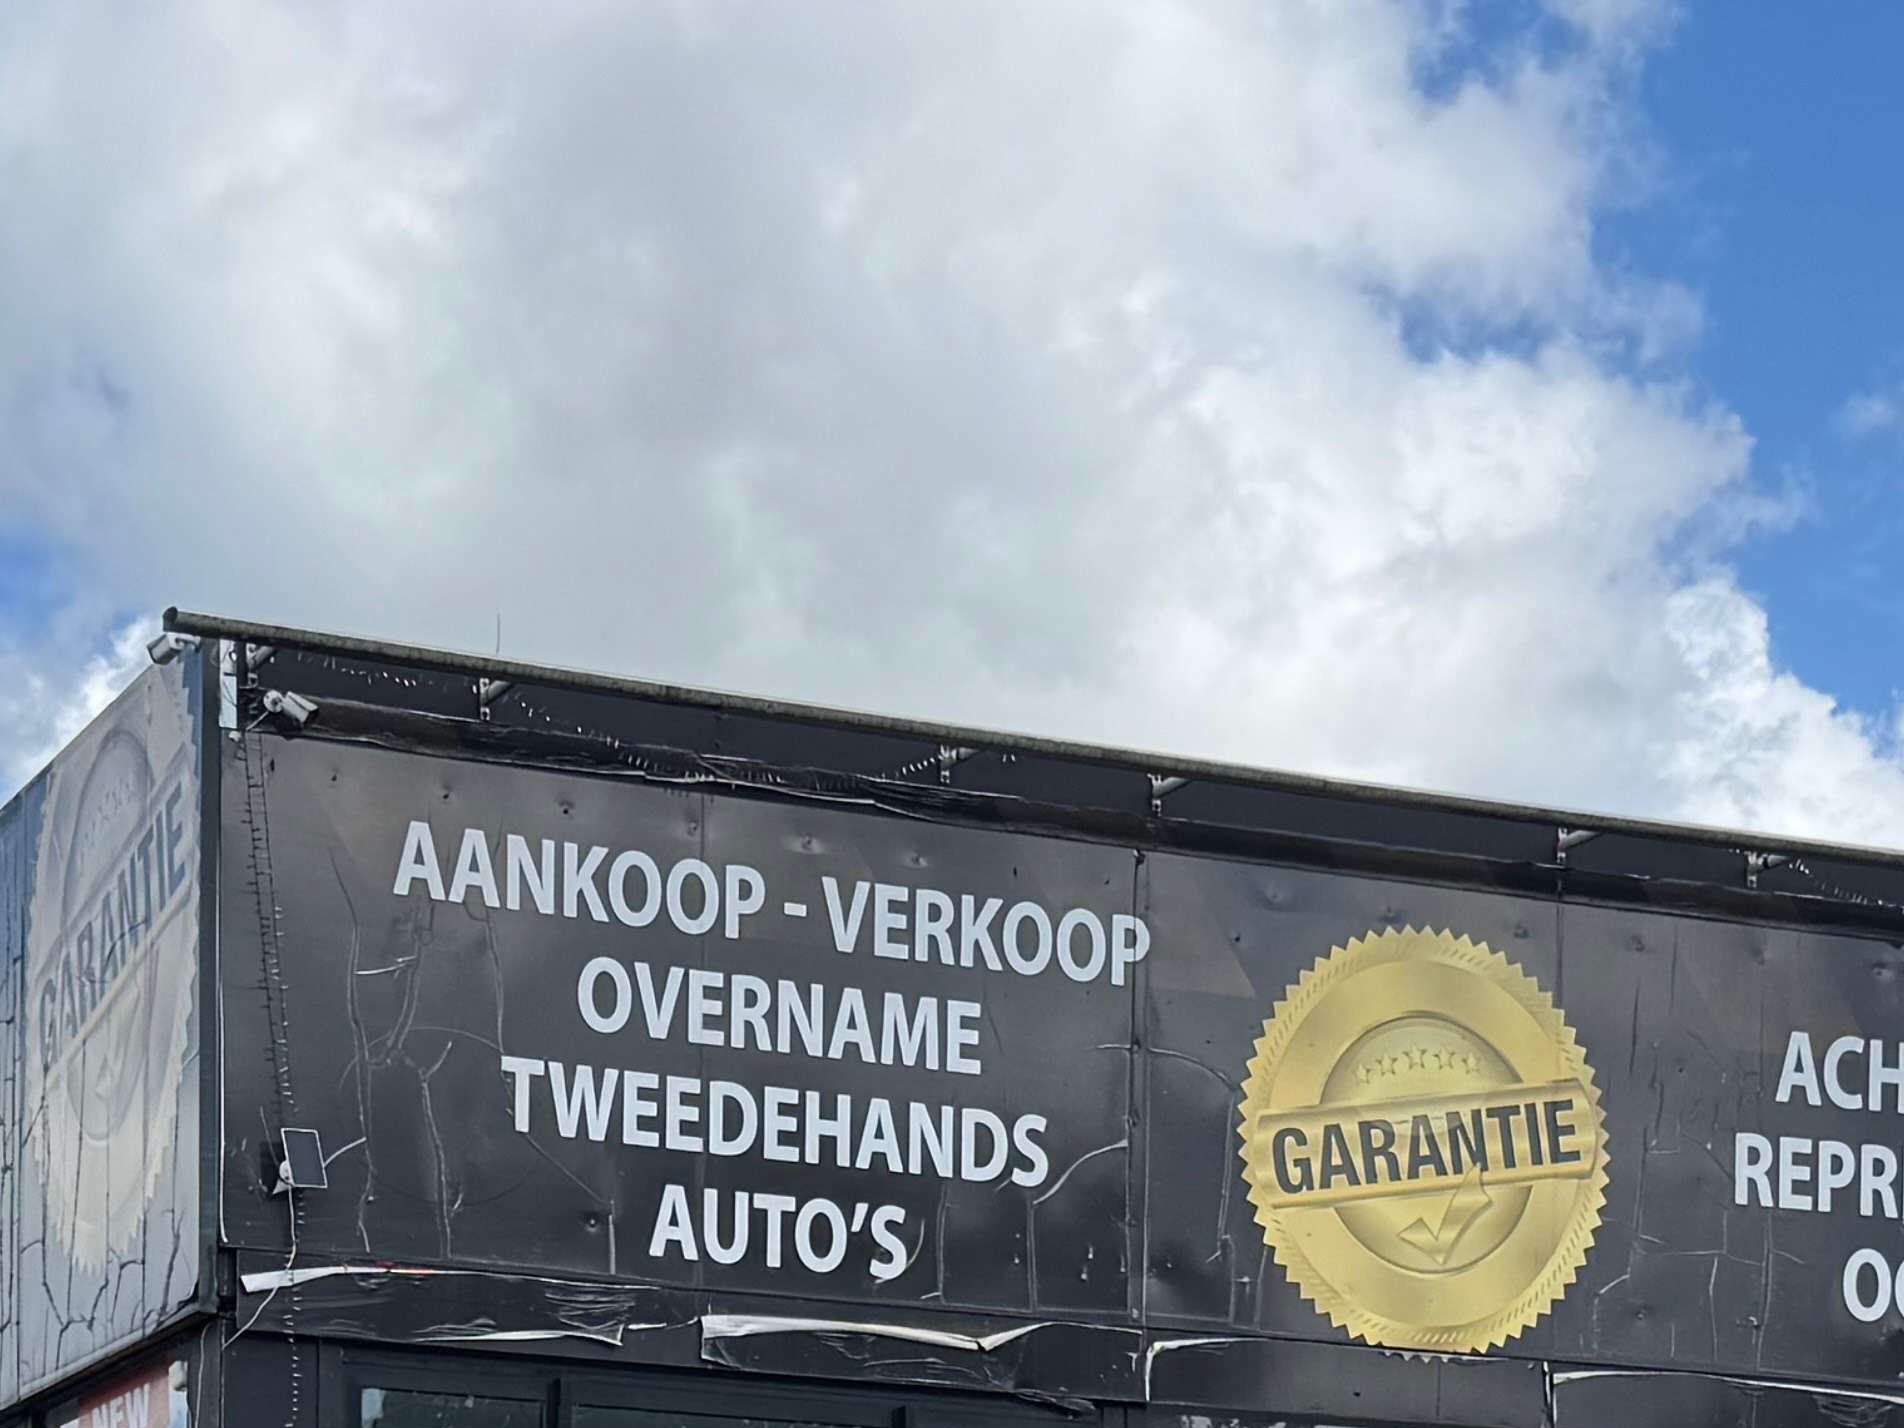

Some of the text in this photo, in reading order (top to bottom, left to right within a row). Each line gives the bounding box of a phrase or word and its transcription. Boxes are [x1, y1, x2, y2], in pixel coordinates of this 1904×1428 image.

[393, 822, 764, 938] AANKOOP
[823, 876, 1151, 986] VERKOOP
[577, 956, 981, 1075] OVERNAME
[500, 1057, 1049, 1188] TWEEDEHANDS
[1272, 1097, 1582, 1194] GARANTIE
[649, 1185, 908, 1281] AUTO'S
